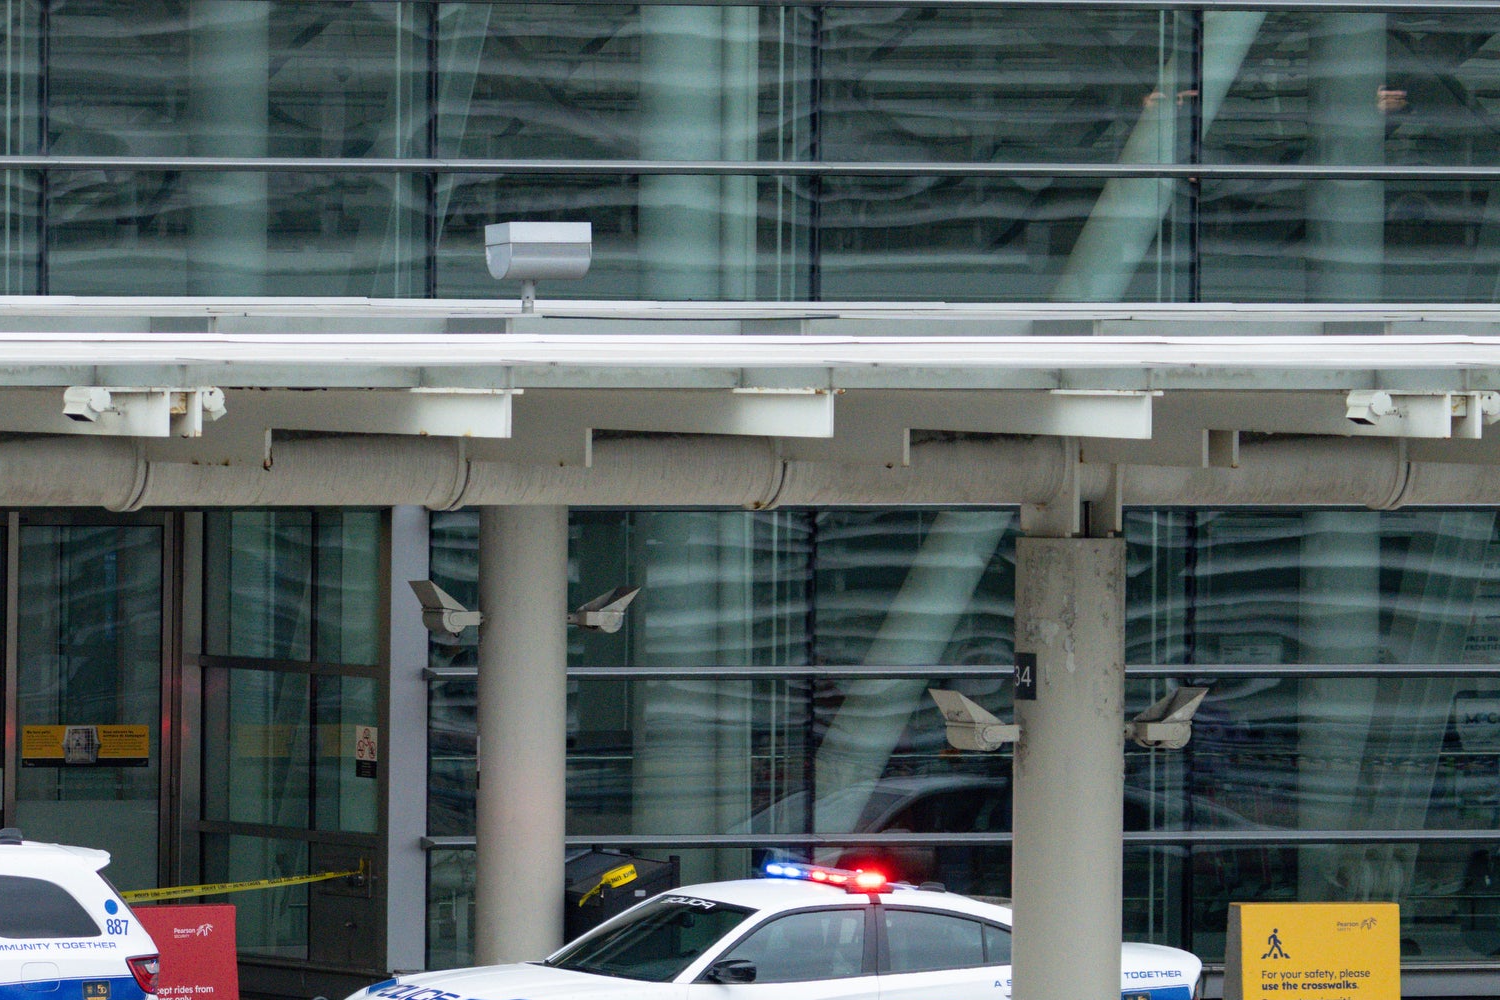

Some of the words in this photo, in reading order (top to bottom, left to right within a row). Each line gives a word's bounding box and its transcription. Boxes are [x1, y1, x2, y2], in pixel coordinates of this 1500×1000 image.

[1014, 665, 1032, 687] 34
[106, 919, 129, 936] 887
[54, 941, 118, 950] TOGETHER
[1123, 970, 1183, 979] TOGETHER
[1261, 970, 1277, 980] For
[1280, 971, 1301, 982] your
[1304, 969, 1337, 980] safety,
[1339, 969, 1371, 979] please
[174, 985, 194, 994] rides
[195, 984, 214, 993] from
[1261, 983, 1279, 991] use
[1282, 981, 1298, 990] the
[1301, 980, 1360, 990] crosswalks.
